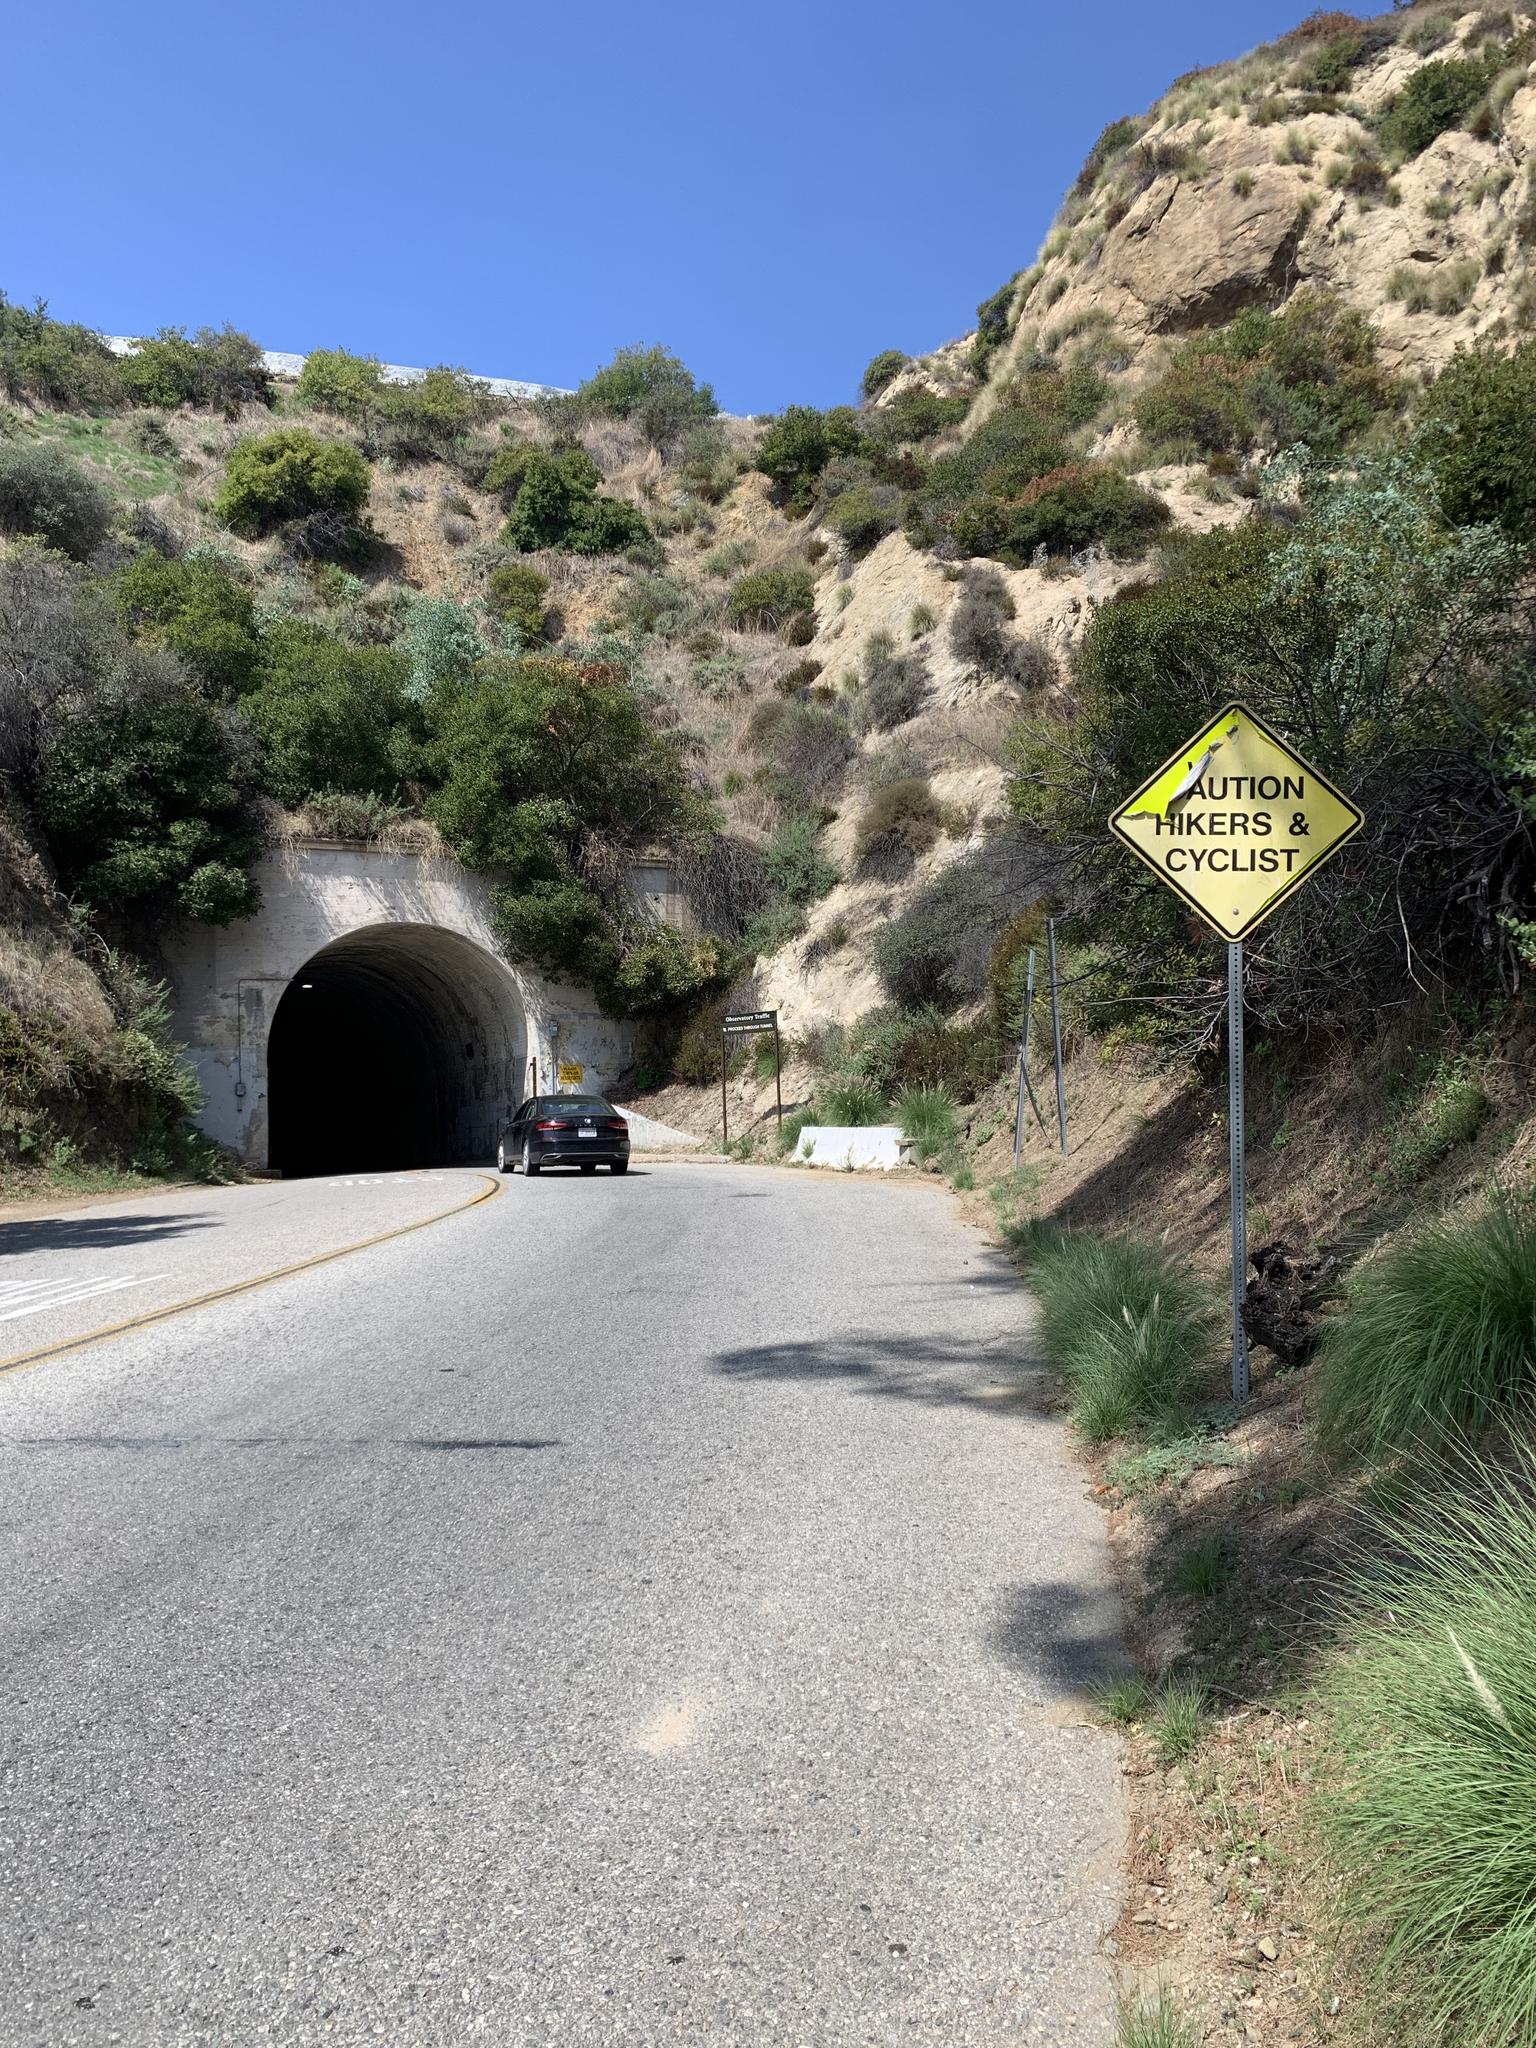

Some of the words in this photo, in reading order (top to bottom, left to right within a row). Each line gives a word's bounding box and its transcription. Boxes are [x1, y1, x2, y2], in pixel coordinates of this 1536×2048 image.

[1185, 775, 1304, 800] AUTION
[1155, 811, 1273, 836] HIKERS
[1288, 811, 1311, 837] &
[1165, 847, 1300, 873] CYCLIST
